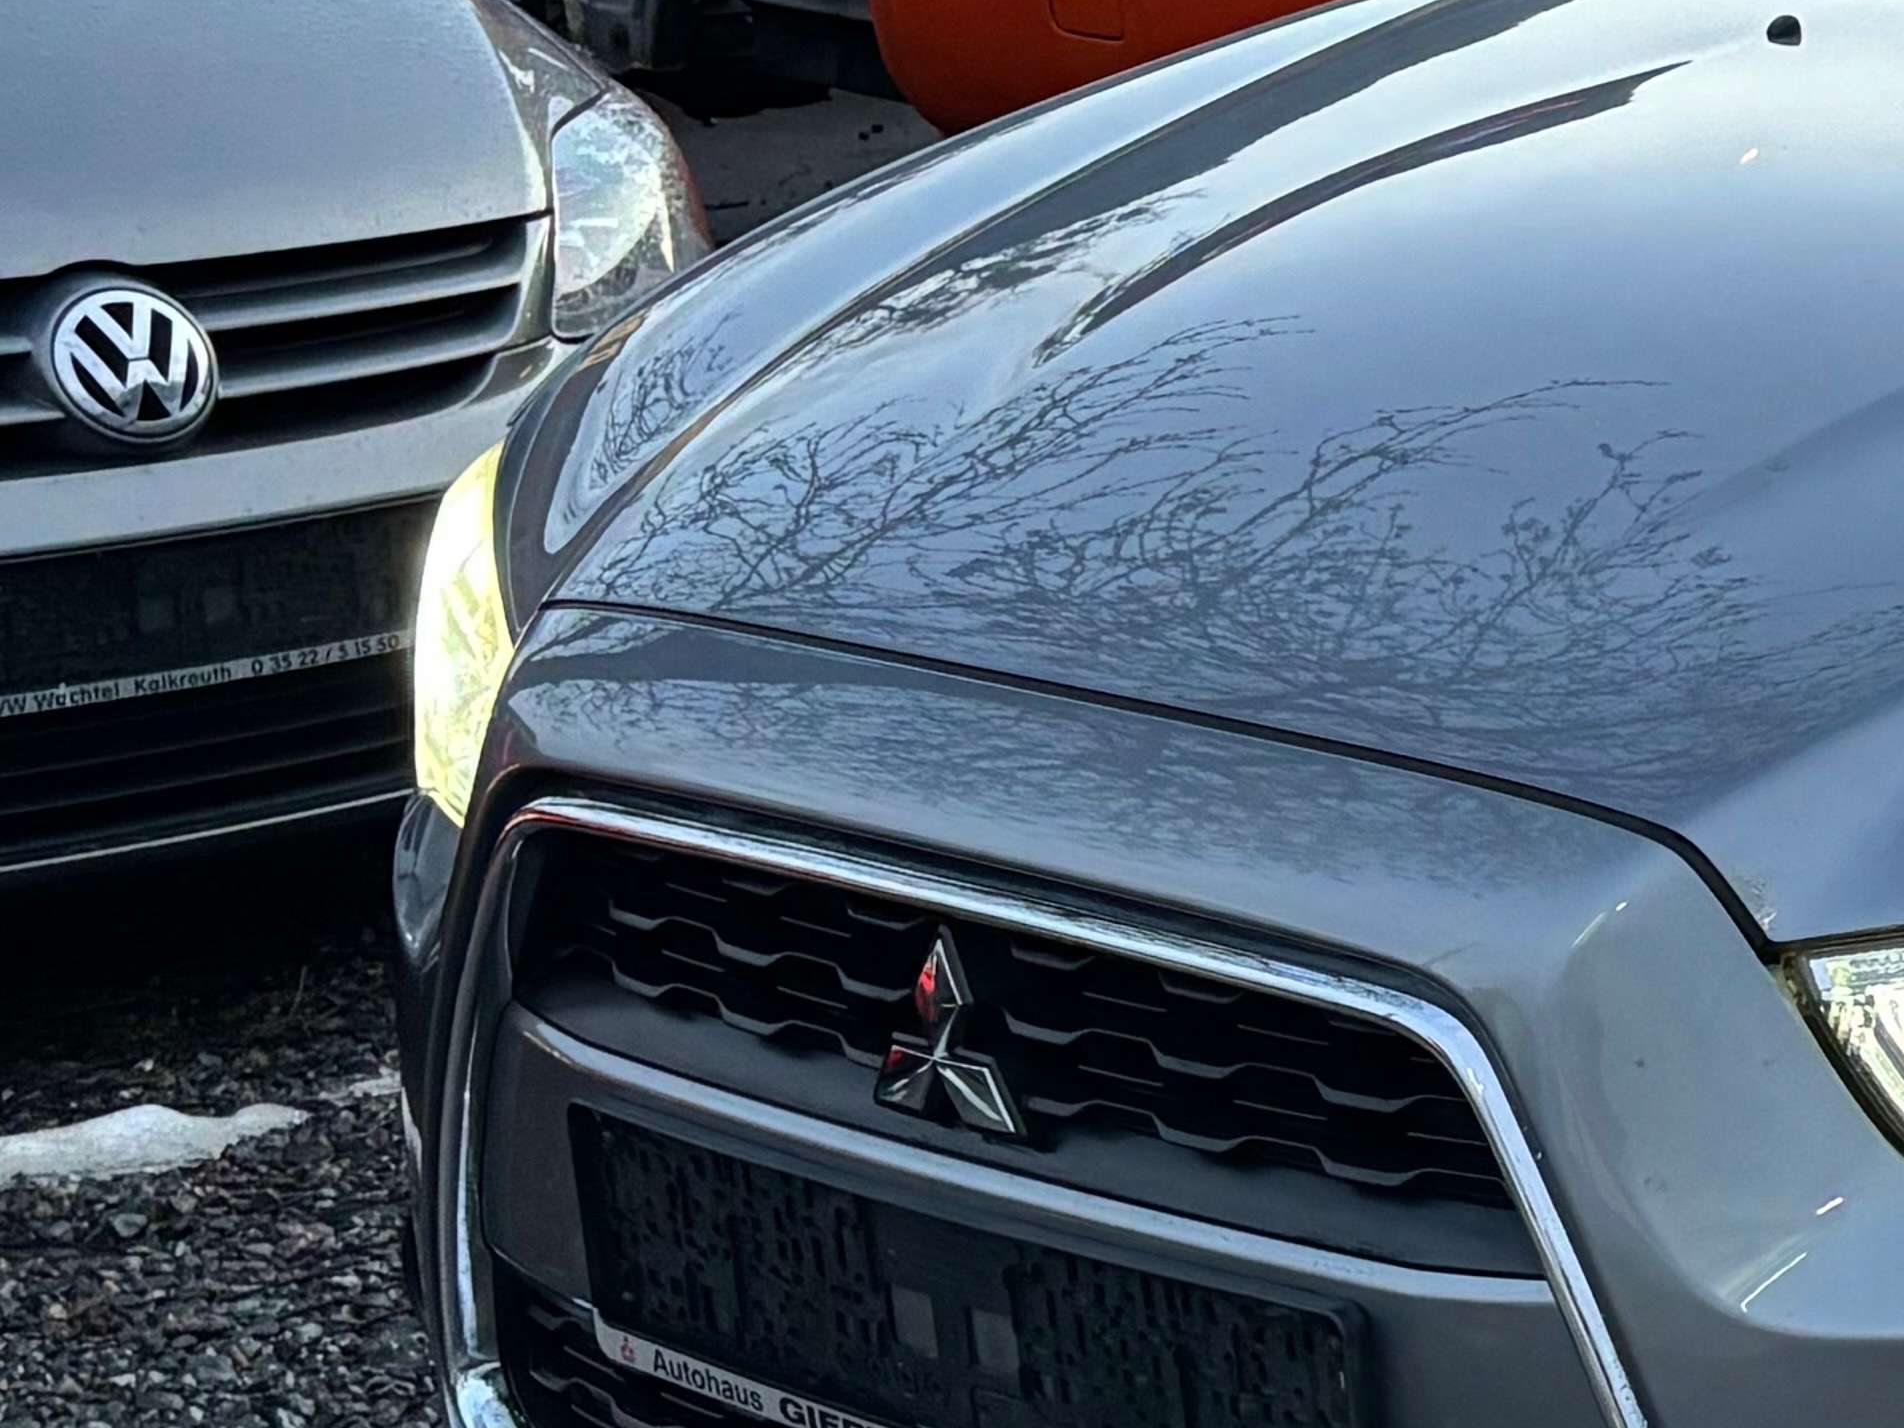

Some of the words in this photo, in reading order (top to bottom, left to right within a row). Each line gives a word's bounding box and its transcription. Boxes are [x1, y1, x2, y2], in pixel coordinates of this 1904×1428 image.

[52, 287, 214, 440] VW
[33, 682, 120, 712] Wachtel
[298, 649, 319, 666] 22
[653, 1348, 764, 1413] Autohaus
